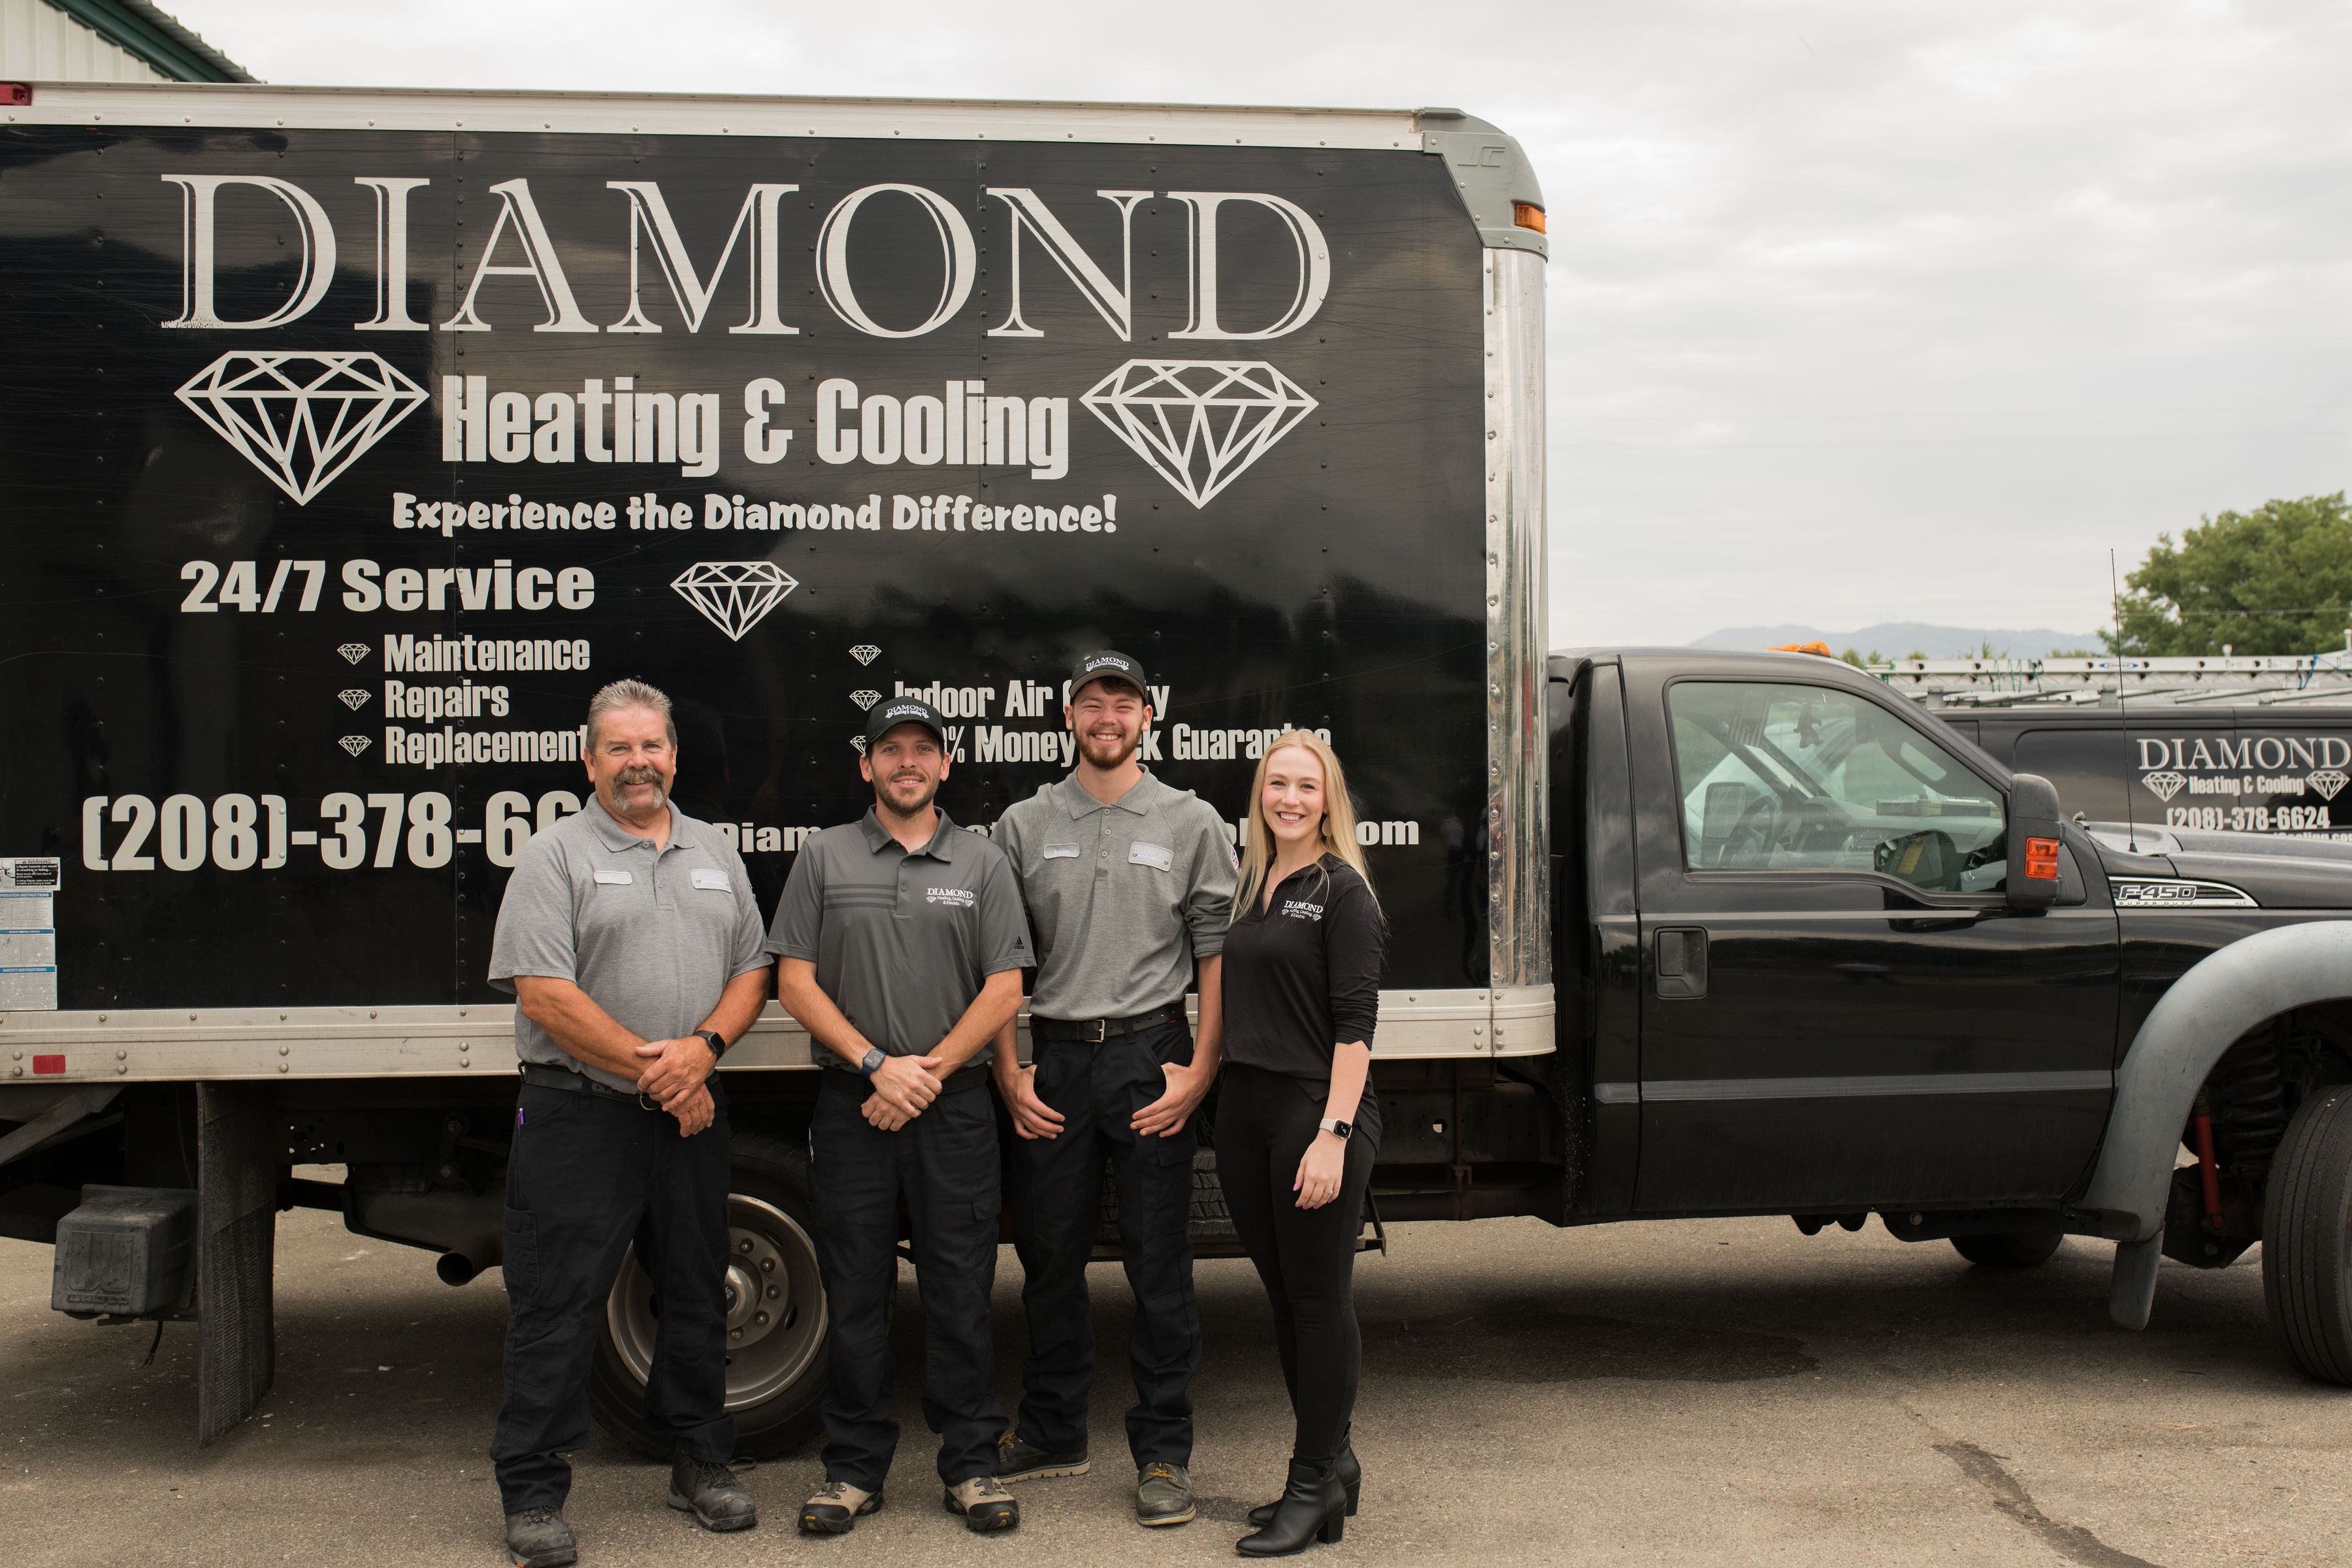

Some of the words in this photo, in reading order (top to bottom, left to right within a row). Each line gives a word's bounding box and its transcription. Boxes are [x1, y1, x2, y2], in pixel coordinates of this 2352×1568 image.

[162, 174, 1330, 342] DIAMOND
[443, 375, 719, 477] Heating
[745, 378, 792, 464] &
[817, 378, 1068, 480] Cooling
[393, 493, 616, 537] Experience
[627, 493, 693, 531] the
[705, 493, 881, 531] Diamond
[892, 494, 1117, 533] Difference!
[181, 560, 325, 613] 24/7
[342, 559, 595, 612] Service
[384, 634, 590, 672] Maintenance
[1085, 657, 1129, 668] DIAMOND
[385, 679, 509, 723] Repairs
[887, 704, 928, 714] DIAMOND
[1004, 680, 1053, 717] Air
[1173, 723, 1331, 760] Guara
[2136, 737, 2352, 770] DIAMOND
[2189, 776, 2241, 796] Heating
[2243, 776, 2254, 792] &
[2257, 775, 2305, 796] Cooling
[2166, 806, 2330, 831] (208)-378-6624
[927, 888, 973, 898] DIAMOND
[1284, 900, 1324, 913] DIAMOND
[2119, 885, 2197, 900] F-450
